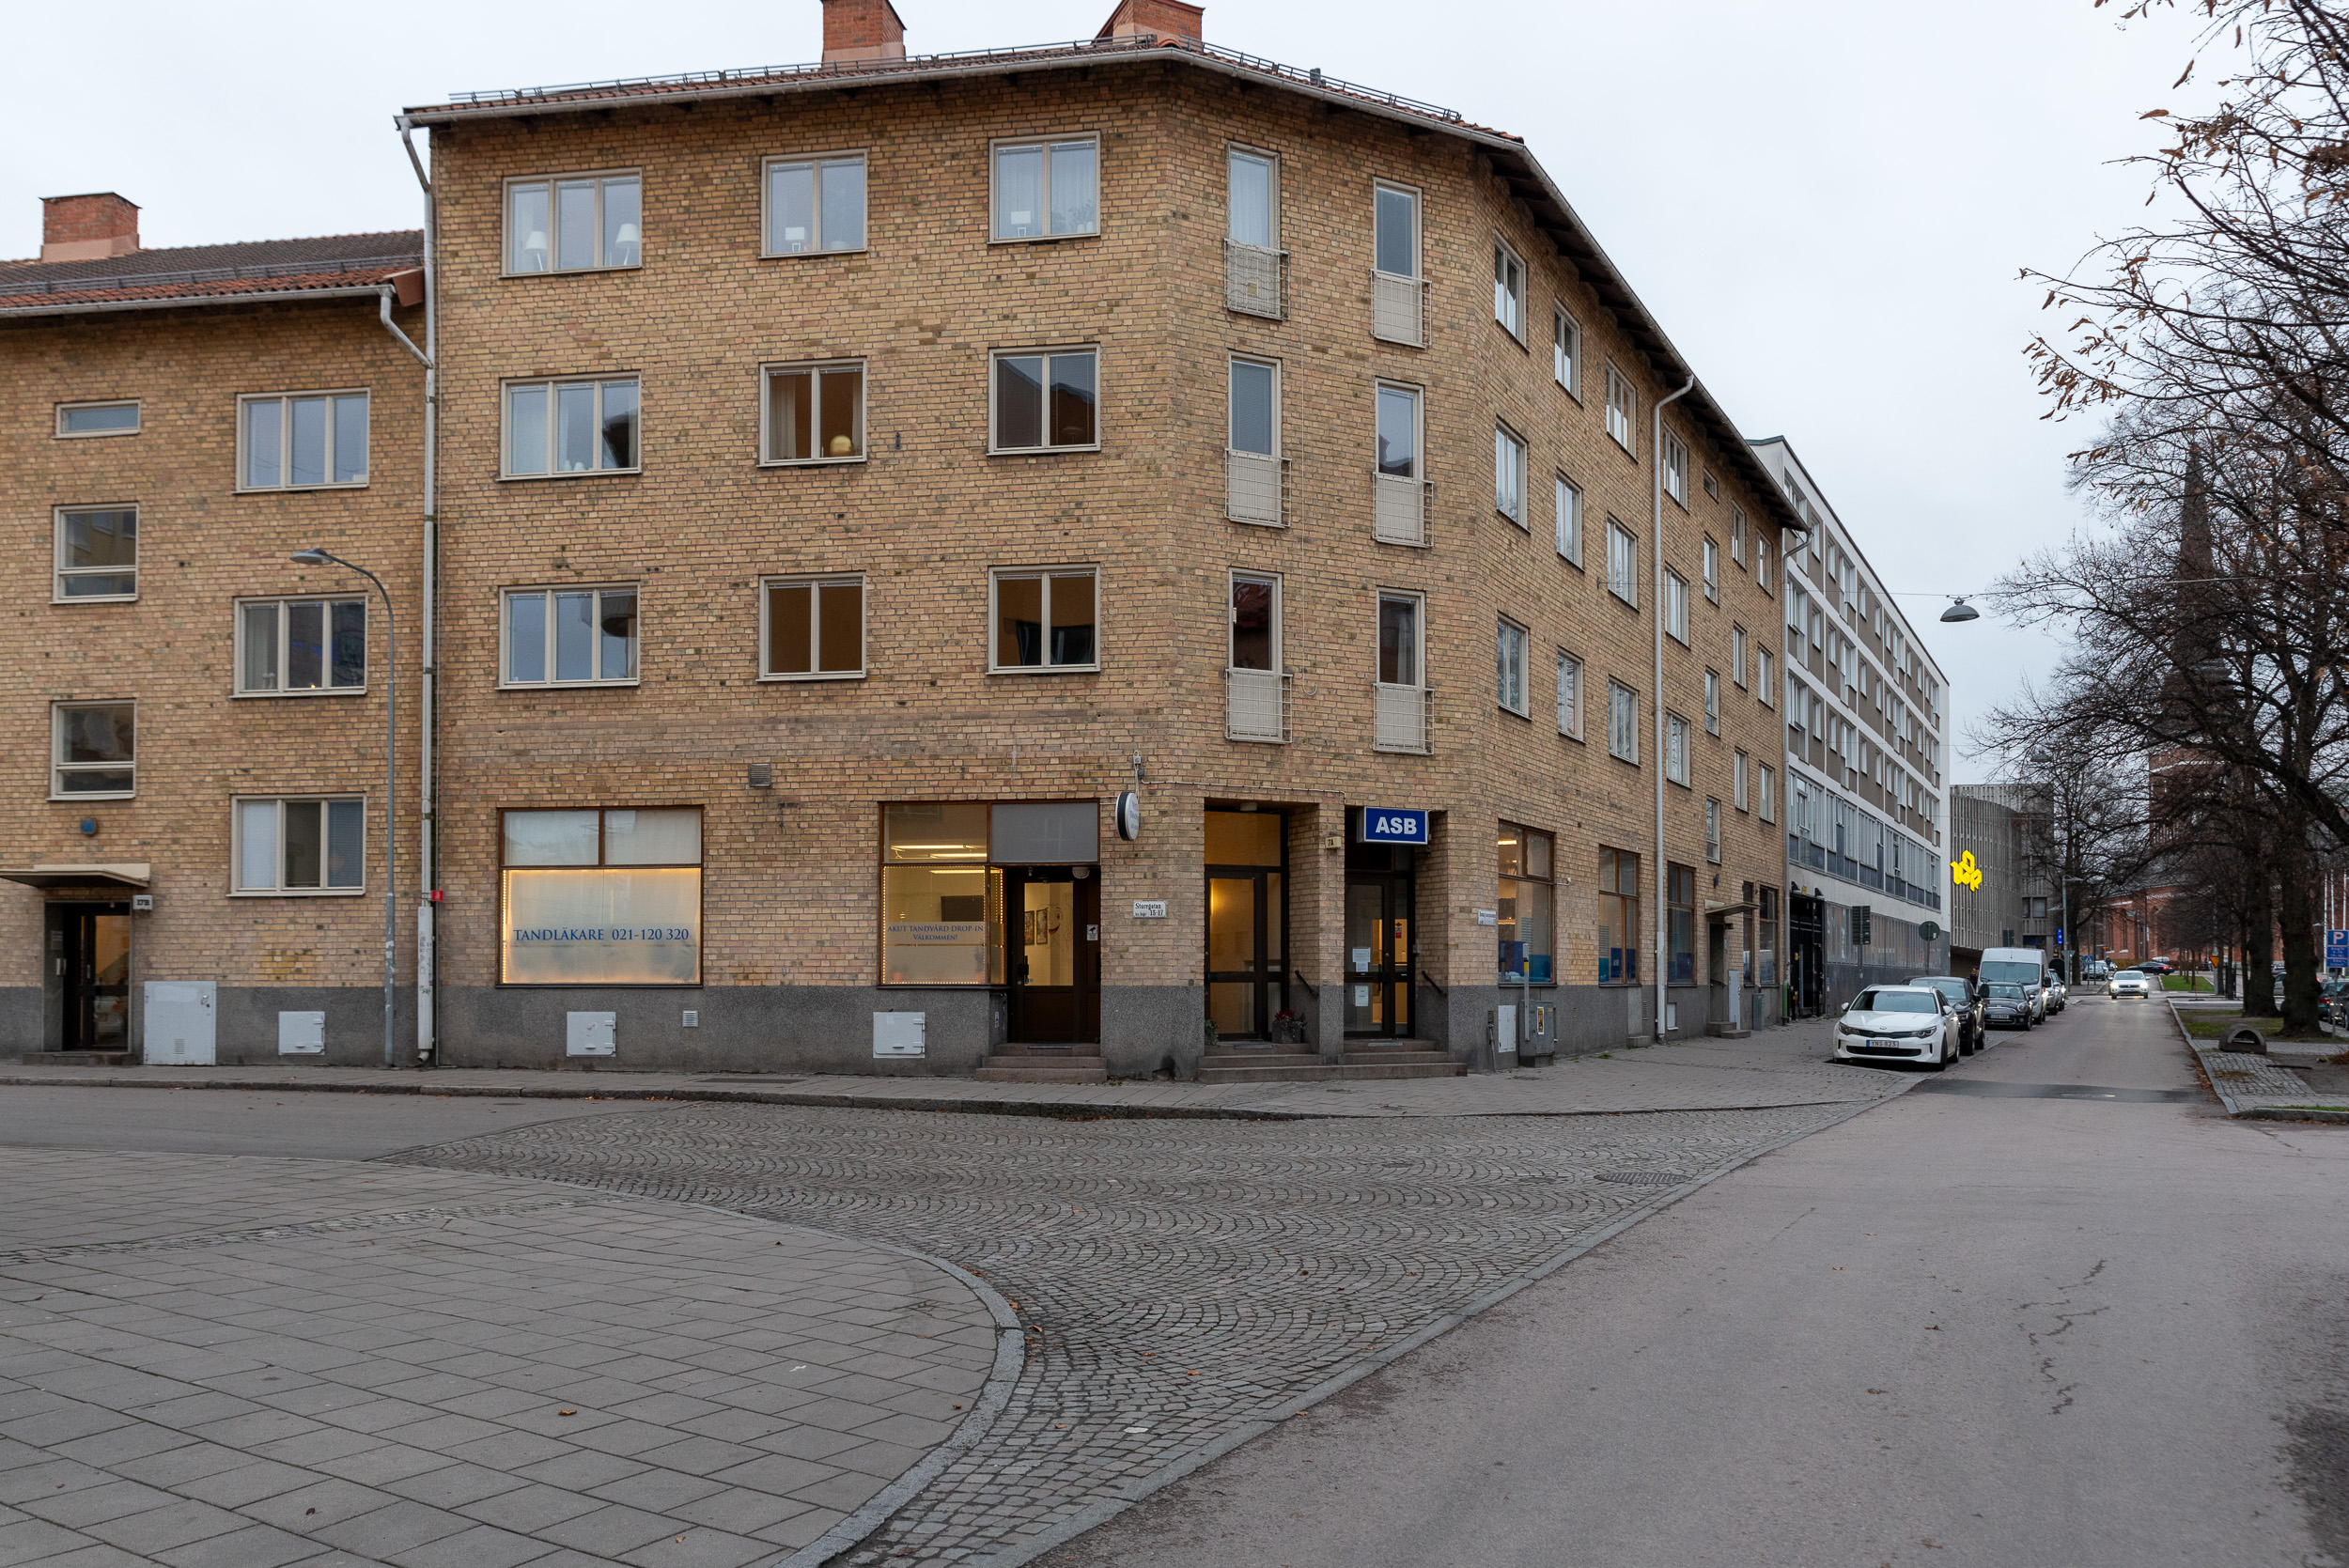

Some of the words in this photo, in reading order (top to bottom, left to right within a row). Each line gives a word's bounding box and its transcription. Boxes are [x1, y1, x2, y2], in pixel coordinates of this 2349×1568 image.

[1376, 816, 1417, 834] ASB
[1328, 838, 1334, 846] 7A
[514, 927, 604, 940] TANDLÄKARE
[612, 928, 662, 940] 021-120
[666, 928, 689, 940] 320
[2333, 932, 2344, 944] P
